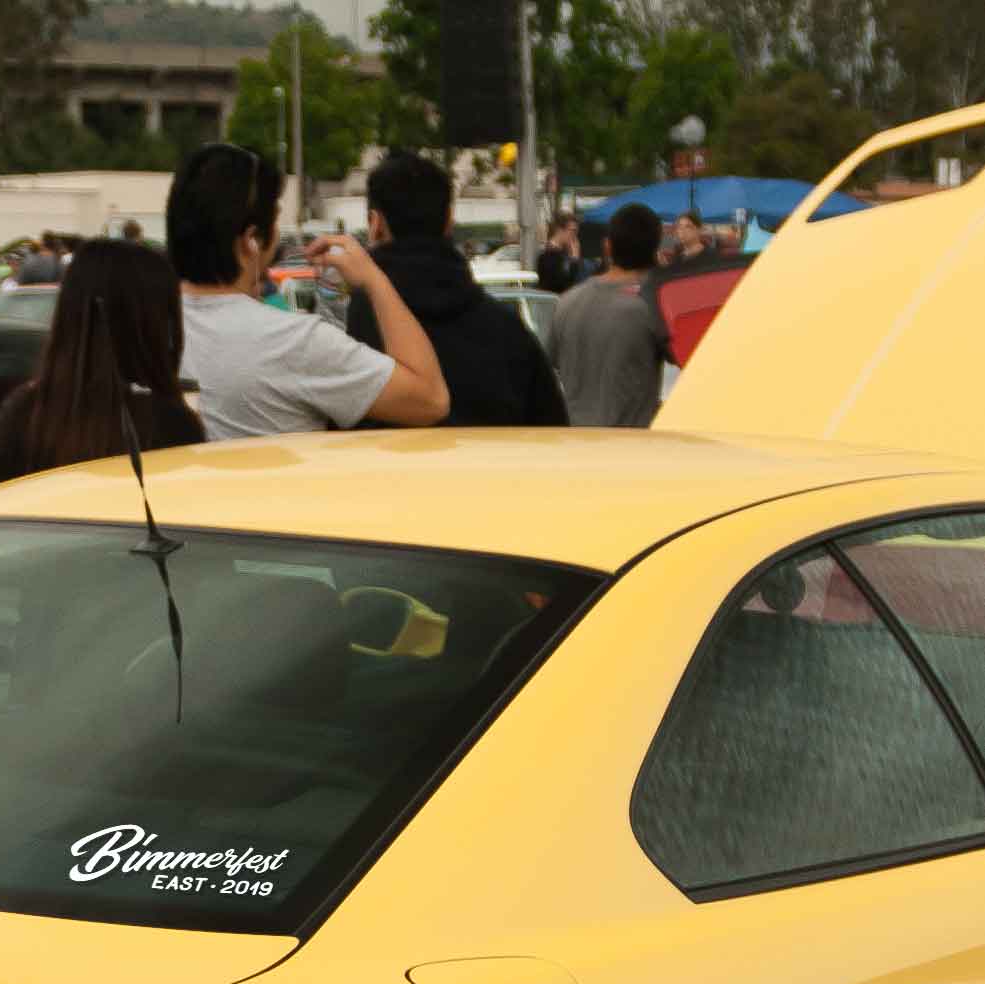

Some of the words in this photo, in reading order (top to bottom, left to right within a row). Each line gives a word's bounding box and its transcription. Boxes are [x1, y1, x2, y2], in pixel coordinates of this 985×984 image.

[69, 824, 290, 882] Bimmerfest
[151, 875, 209, 892] EAST
[219, 879, 274, 896] 2019
